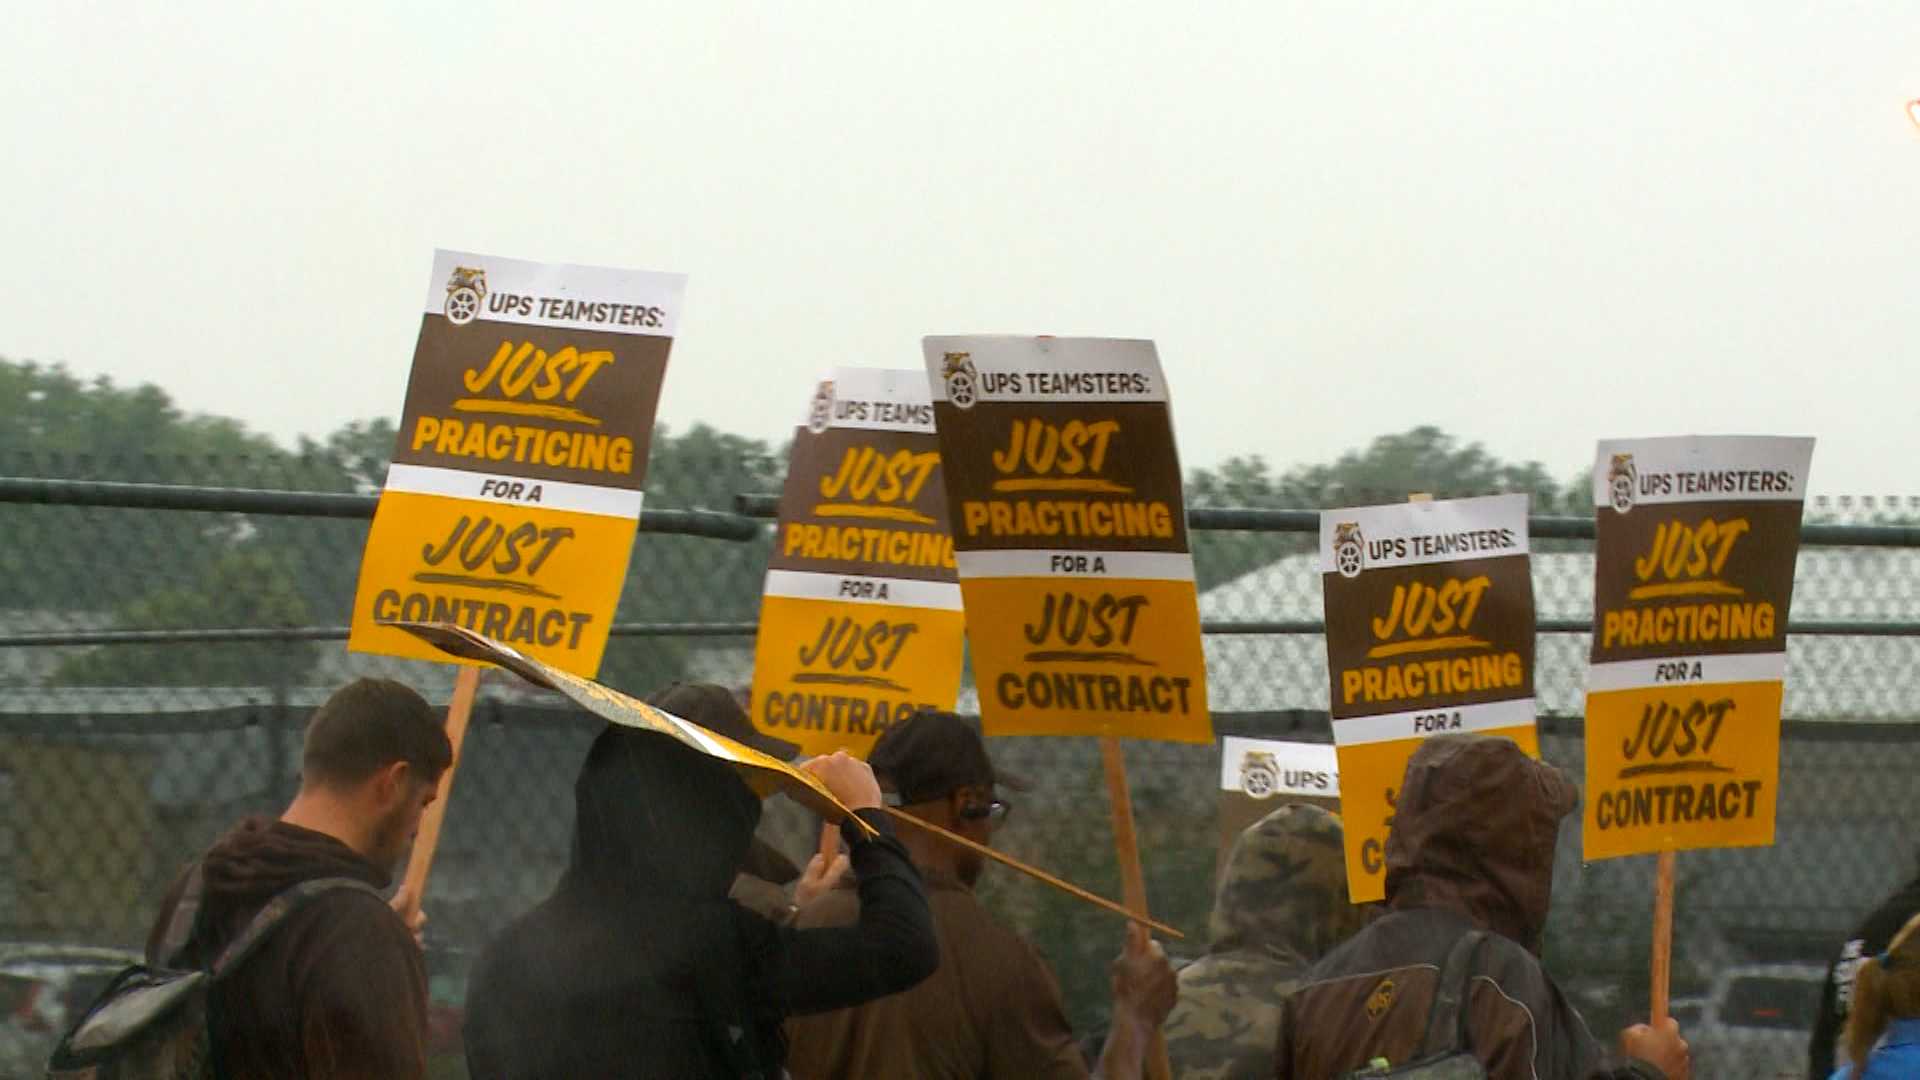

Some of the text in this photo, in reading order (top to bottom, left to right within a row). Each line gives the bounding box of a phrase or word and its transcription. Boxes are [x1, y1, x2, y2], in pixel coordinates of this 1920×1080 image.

[489, 292, 666, 328] UPS TEAMSTERS:
[463, 340, 614, 402] JUST
[983, 372, 1151, 395] UPS TEAMSTERS:
[835, 399, 868, 420] UPS
[411, 416, 634, 475] PRACTICING
[992, 417, 1121, 474] JUST
[480, 478, 544, 502] FOR A
[820, 446, 942, 503] JUST
[1639, 470, 1795, 496] UPS TEAMSTERS:
[964, 501, 1175, 539] PRACTICING
[421, 515, 575, 577] JUST
[1051, 555, 1107, 573] FOR A
[1369, 529, 1517, 561] UPS TEAMSTERS:
[1635, 517, 1751, 582] JUST
[839, 579, 889, 601] FOR A
[1373, 576, 1493, 641] JUST
[373, 588, 594, 650] CONTRACT
[1024, 593, 1150, 648] JUST
[1603, 602, 1777, 649] PRACTICING
[800, 616, 919, 672] JUST
[998, 672, 1192, 715] CONTRACT
[1343, 651, 1524, 705] PRACTICING
[1654, 661, 1703, 682] FOR A
[764, 690, 938, 736] CONTRA
[1414, 713, 1462, 733] FOR A
[1623, 698, 1737, 761] JUST
[1285, 769, 1329, 790] UPS
[1596, 780, 1762, 831] CONTRACT
